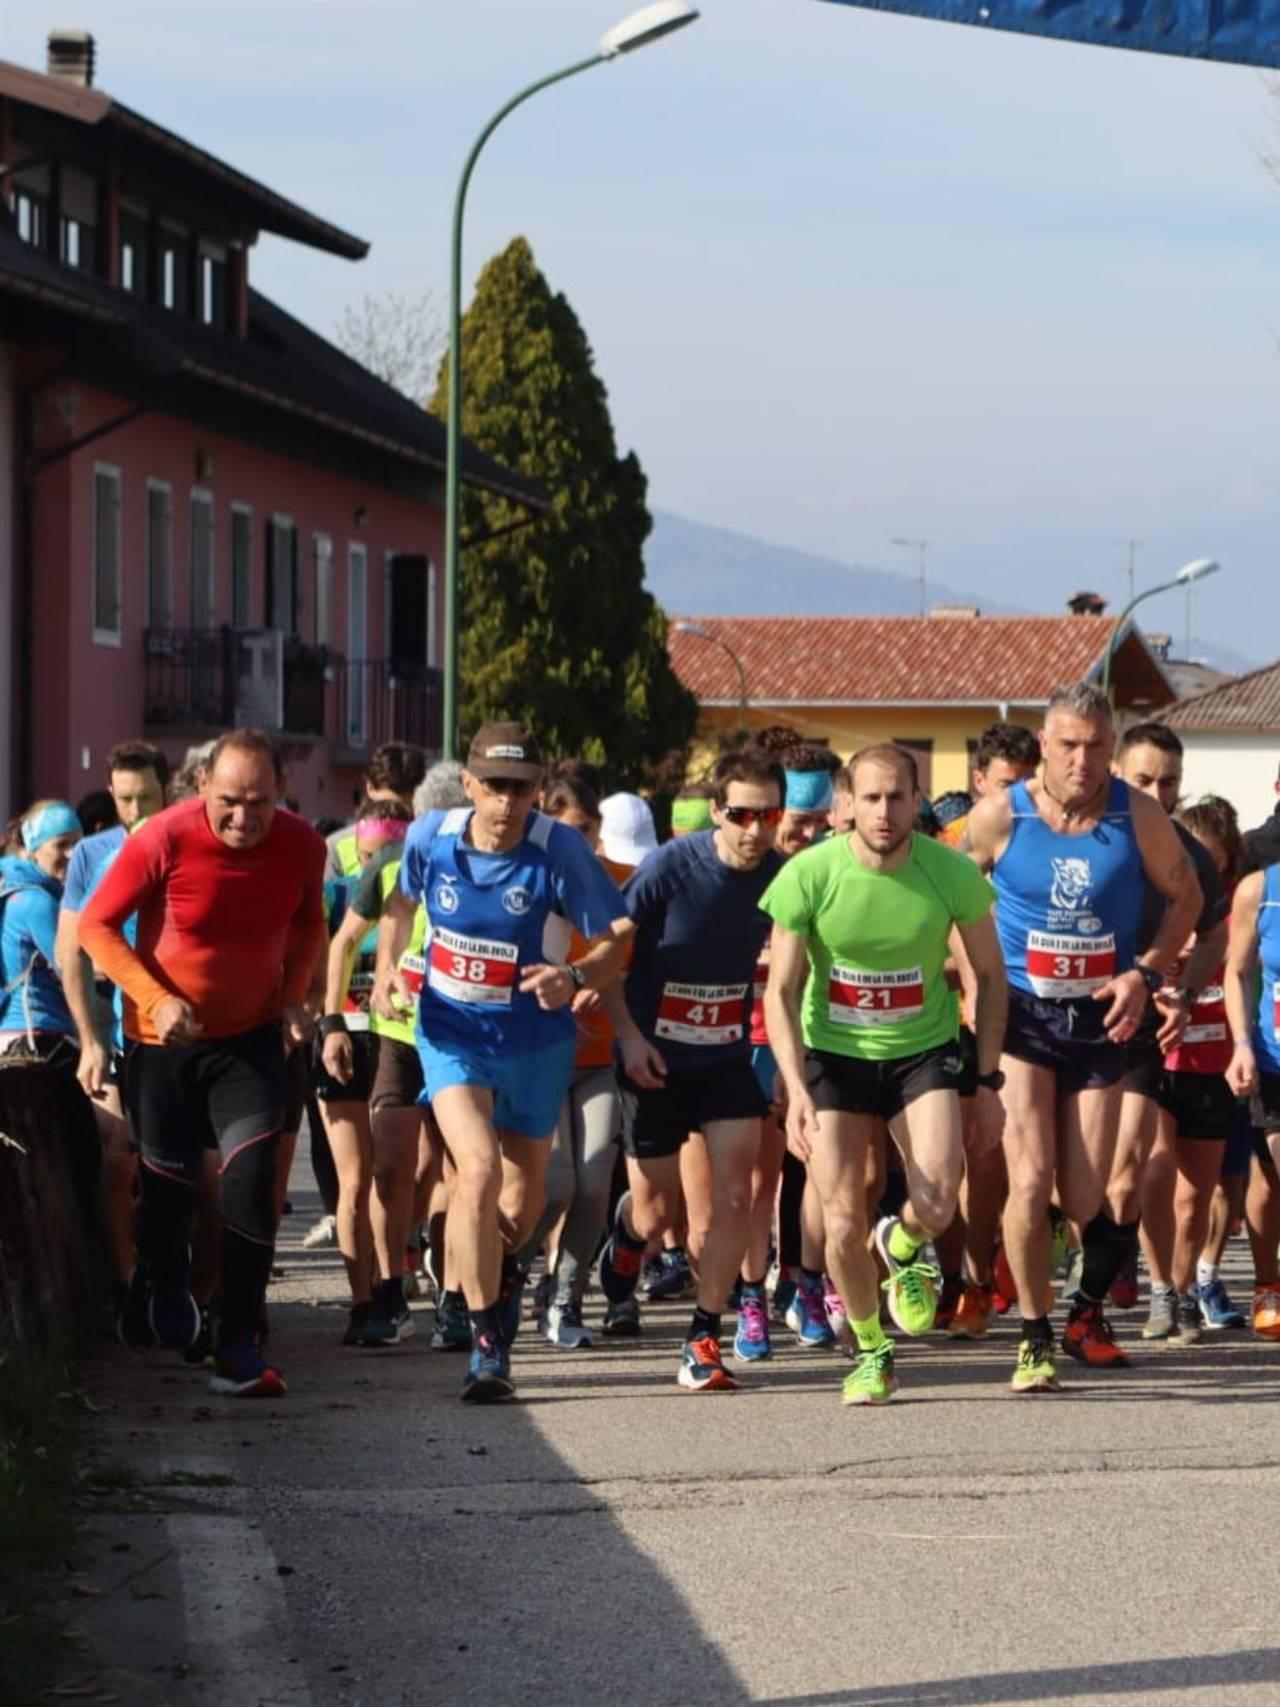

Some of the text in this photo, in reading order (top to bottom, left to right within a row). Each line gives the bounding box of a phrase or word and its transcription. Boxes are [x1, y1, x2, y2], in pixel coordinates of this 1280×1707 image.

[448, 955, 487, 982] 38
[1052, 956, 1088, 977] 31
[856, 989, 891, 1008] 21
[685, 1004, 720, 1025] 41
